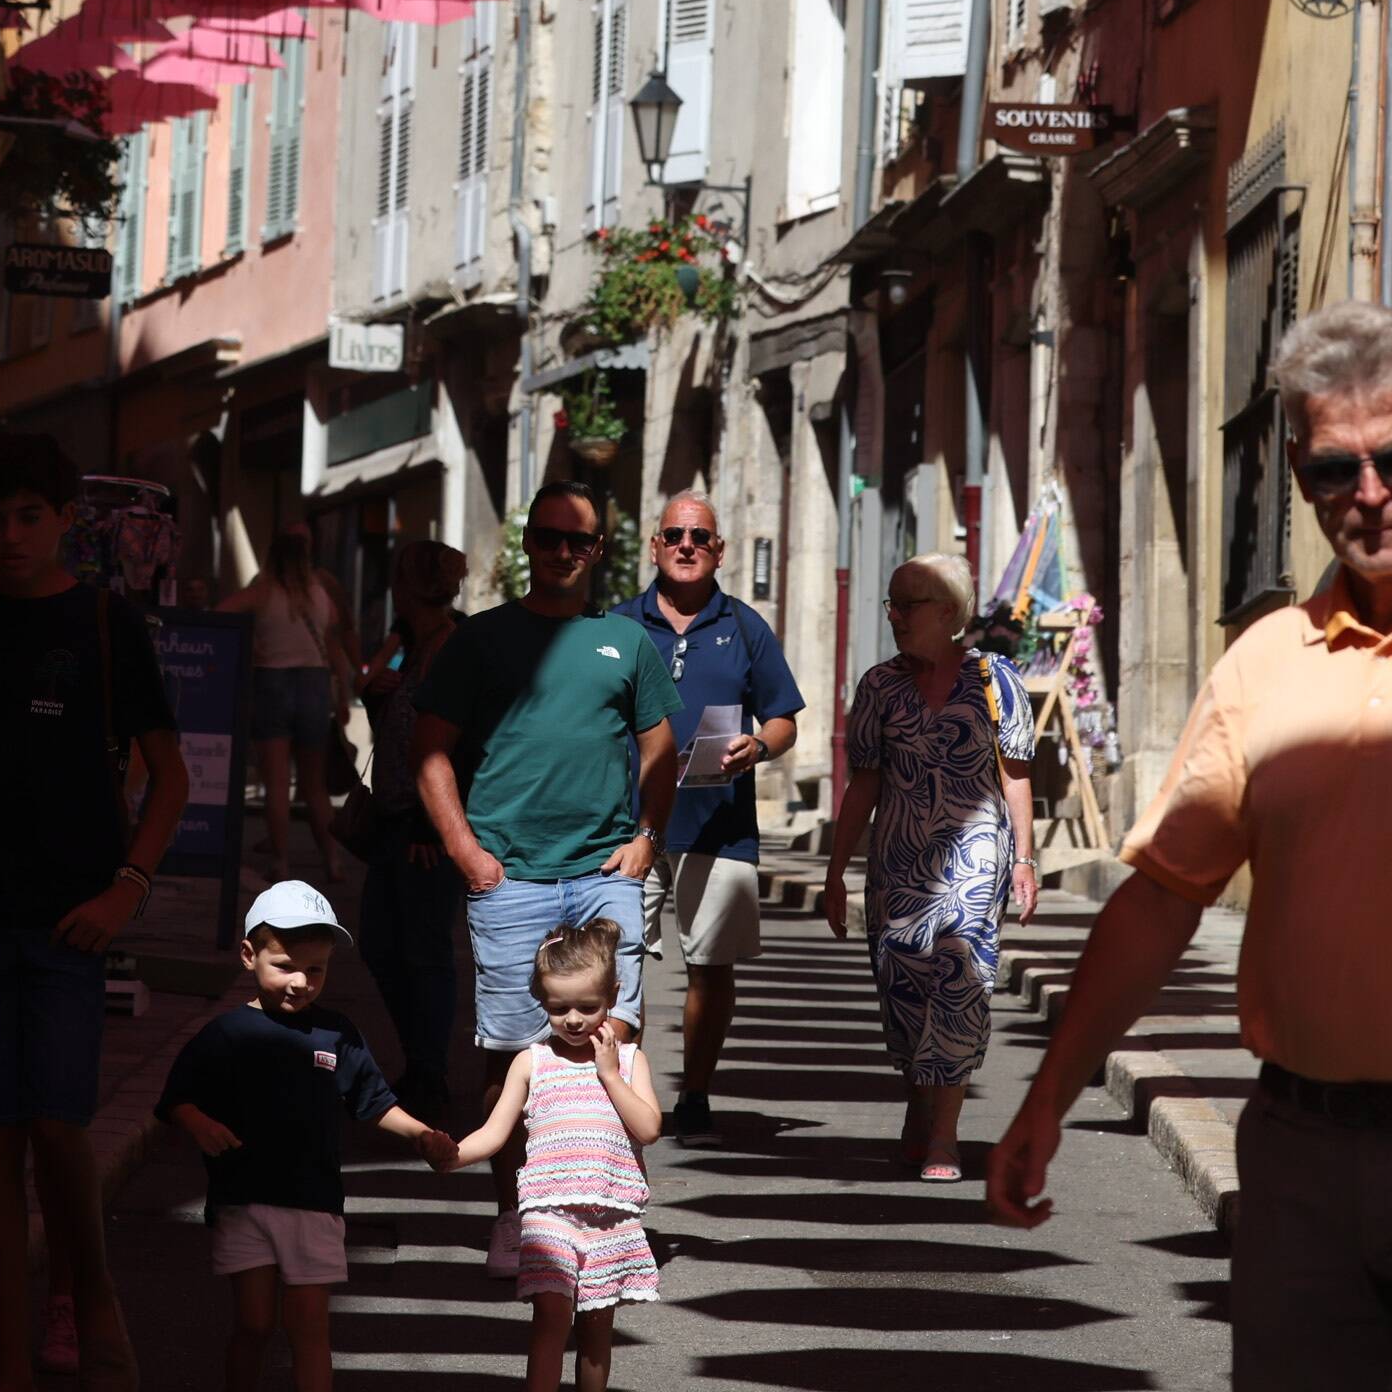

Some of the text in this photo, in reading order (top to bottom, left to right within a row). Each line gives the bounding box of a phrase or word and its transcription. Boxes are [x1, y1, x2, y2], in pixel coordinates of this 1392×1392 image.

[995, 109, 1109, 128] SOUVENIRS
[1028, 133, 1076, 145] GRASSE
[337, 328, 398, 365] Livres
[31, 698, 64, 709] UNKNOWN
[30, 706, 63, 716] PARADISE
